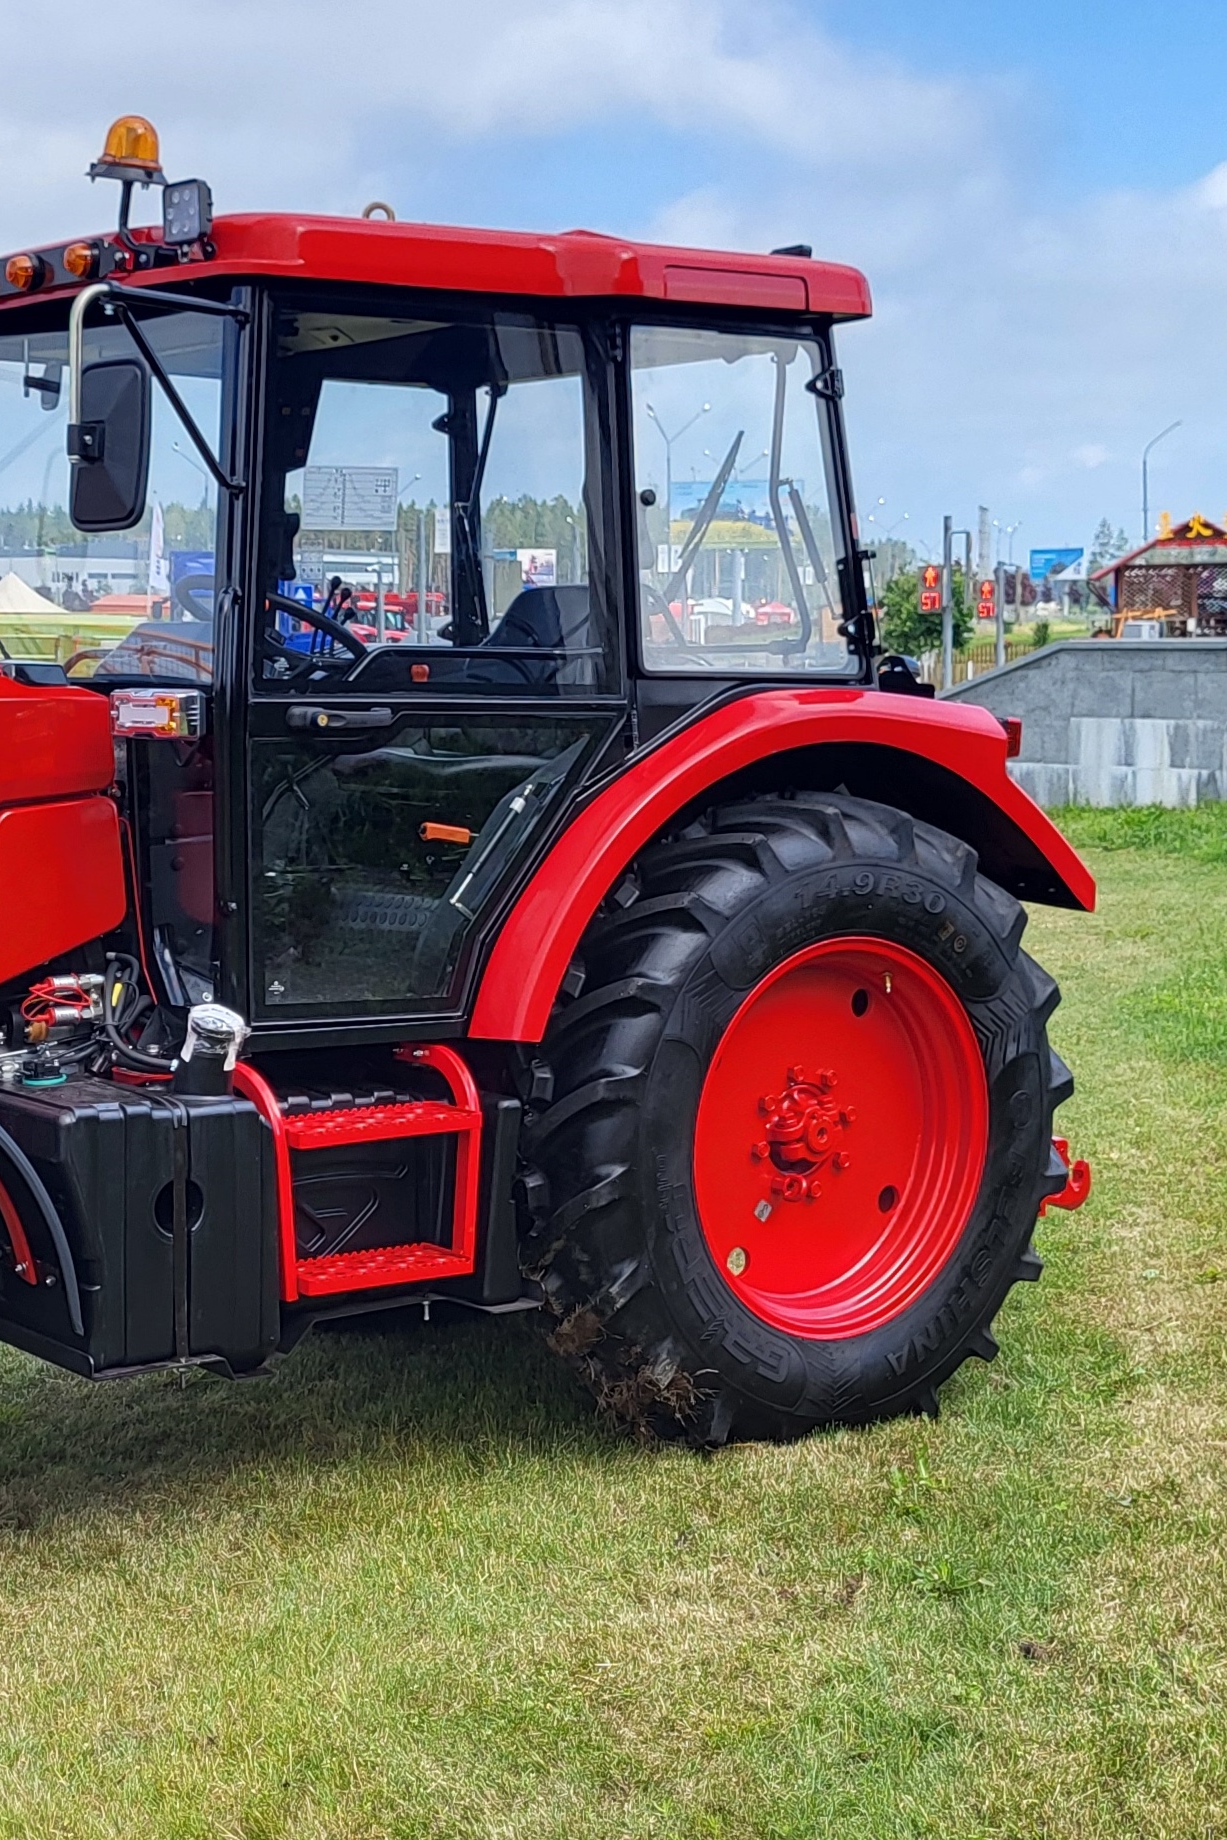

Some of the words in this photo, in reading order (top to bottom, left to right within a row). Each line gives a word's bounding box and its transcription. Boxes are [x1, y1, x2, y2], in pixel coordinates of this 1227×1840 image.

[921, 592, 941, 611] 57
[977, 602, 996, 618] 57
[794, 871, 947, 914] 14.9R30
